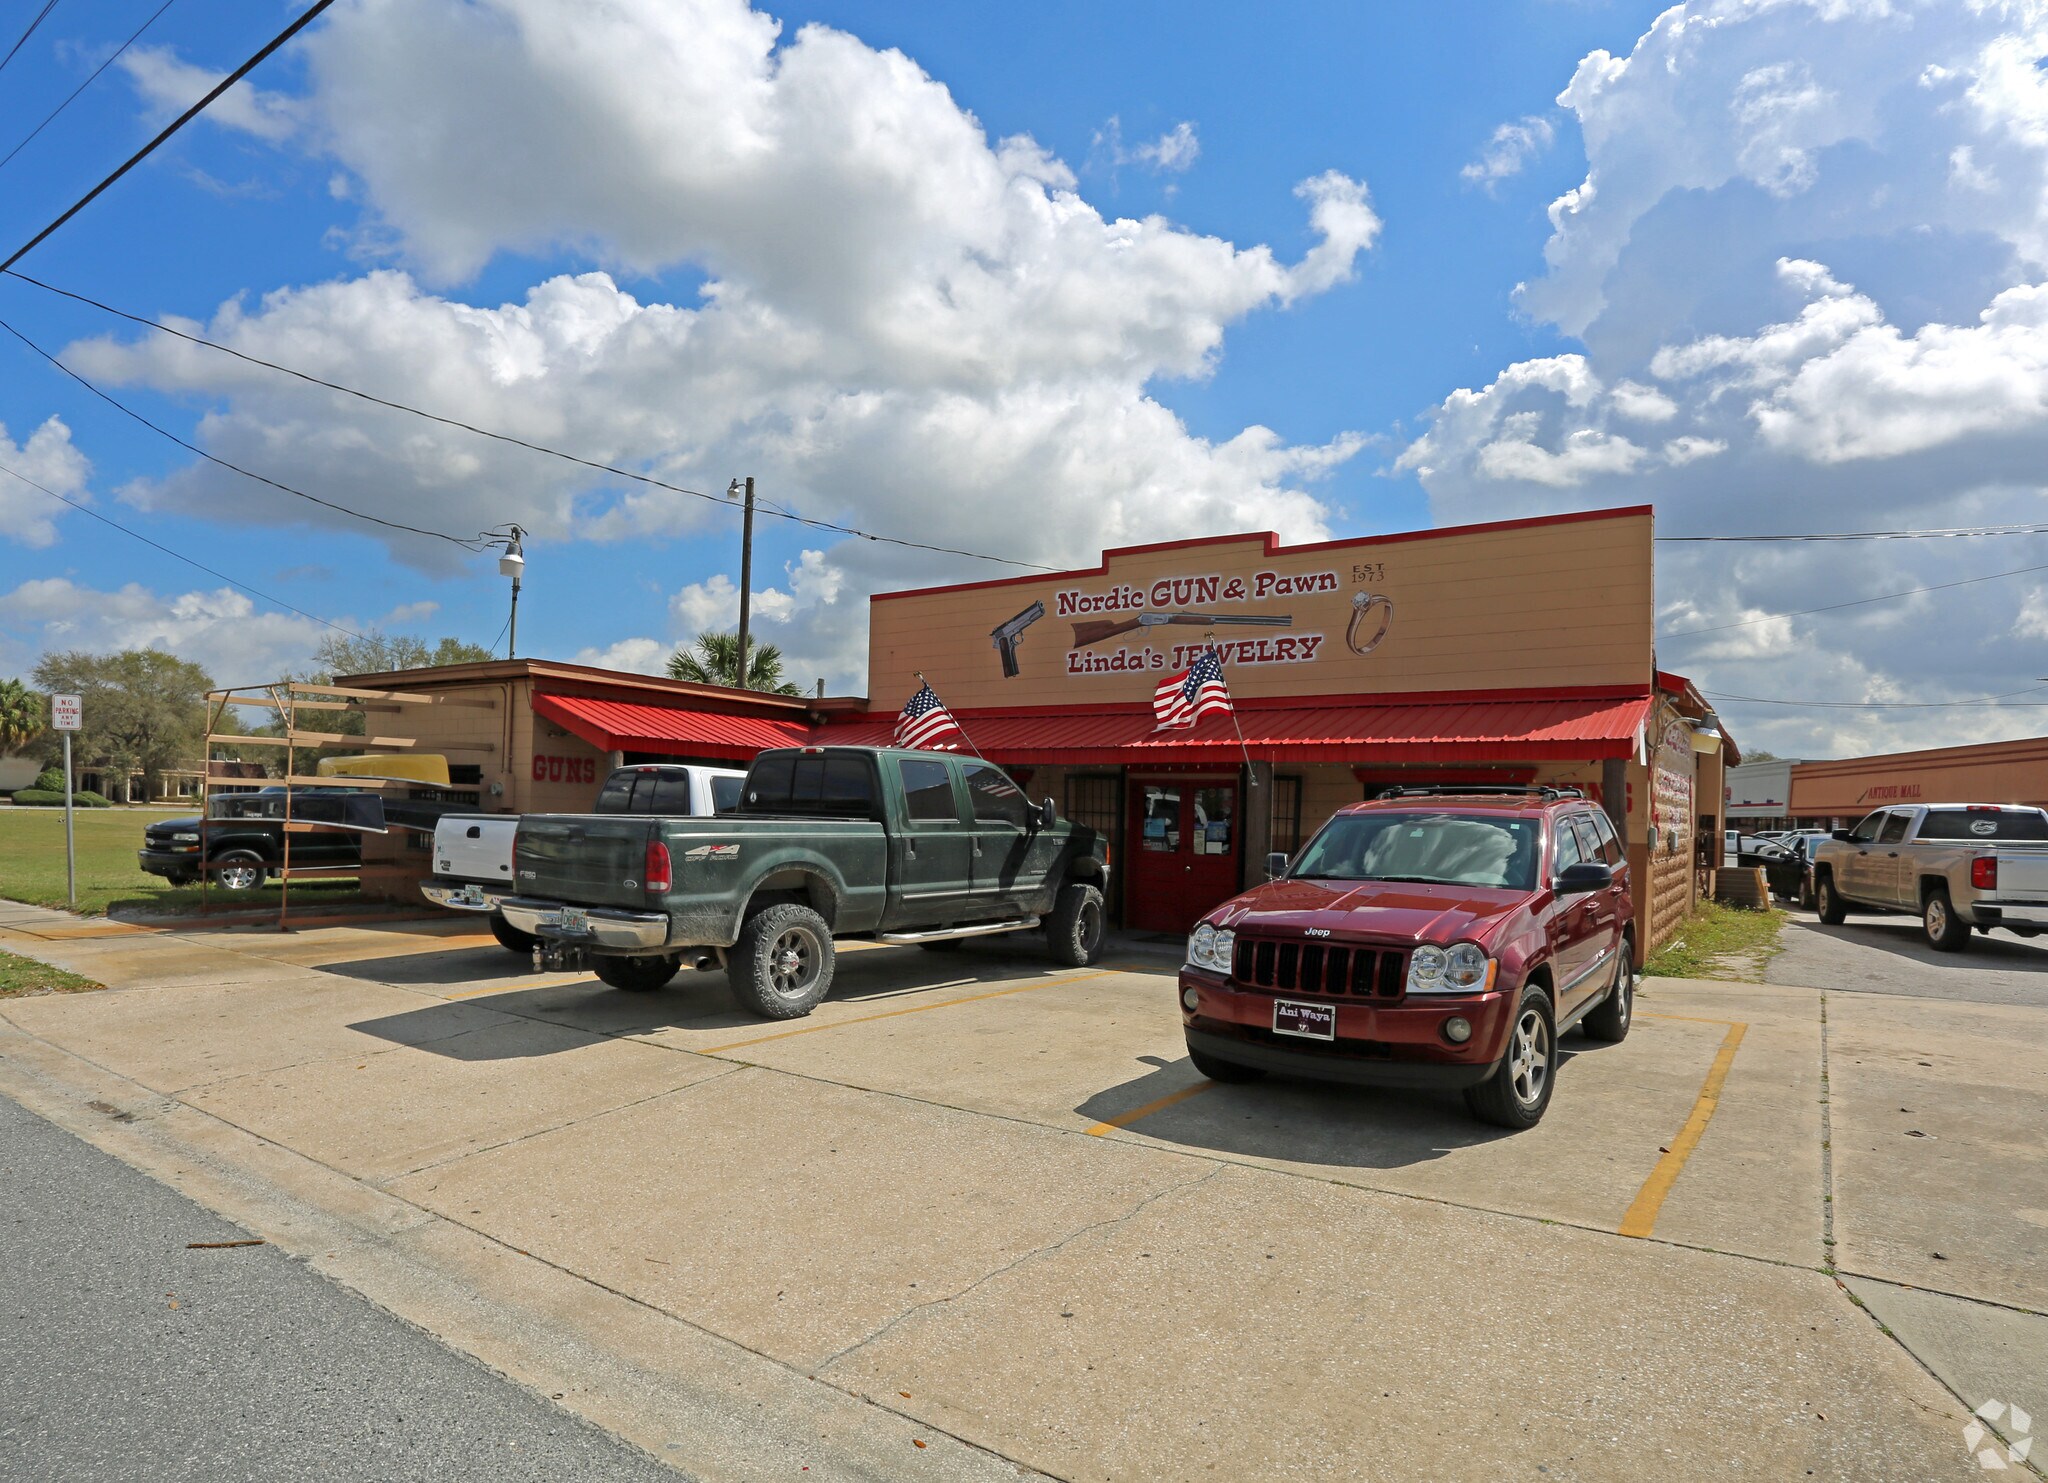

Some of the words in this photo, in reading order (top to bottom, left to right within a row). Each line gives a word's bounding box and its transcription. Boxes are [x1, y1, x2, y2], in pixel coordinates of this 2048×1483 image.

[1351, 571, 1385, 583] 1973
[1057, 586, 1144, 615] Nordic
[1151, 576, 1220, 607] GUN
[1222, 578, 1246, 600] &
[1254, 572, 1338, 597] Pawn
[1068, 648, 1164, 673] Linda's
[1171, 636, 1323, 670] JEWELRY
[55, 707, 79, 715] PARKING
[532, 754, 596, 784] GUNS
[1867, 785, 1898, 799] ANTIQUE
[1900, 784, 1922, 798] MALL
[1304, 927, 1331, 937] Jeep
[1278, 1006, 1299, 1018] Ani
[1299, 1008, 1331, 1022] Waya
